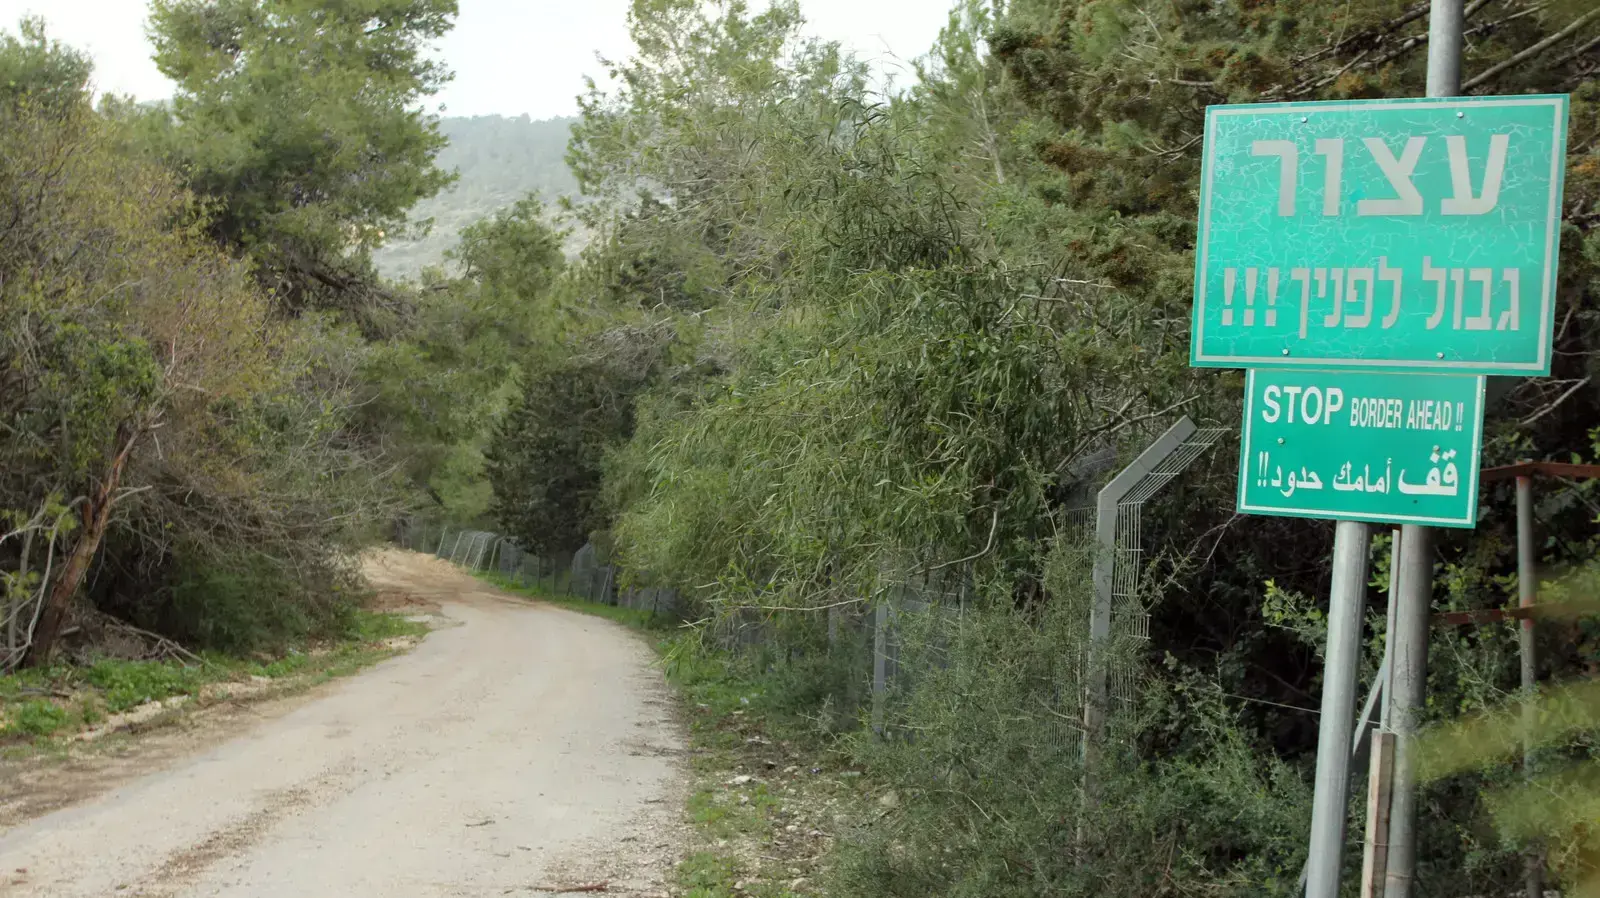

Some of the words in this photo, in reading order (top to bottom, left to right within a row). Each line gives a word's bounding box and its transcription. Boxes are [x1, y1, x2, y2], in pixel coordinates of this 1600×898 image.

[1252, 134, 1510, 216] עצור
[1422, 255, 1520, 331] גבול
[1262, 384, 1344, 425] STOP
[1350, 397, 1403, 429] BORDER
[1406, 399, 1452, 431] AHEAD
[1332, 457, 1392, 495] أمامك
[1398, 448, 1459, 496] قف
